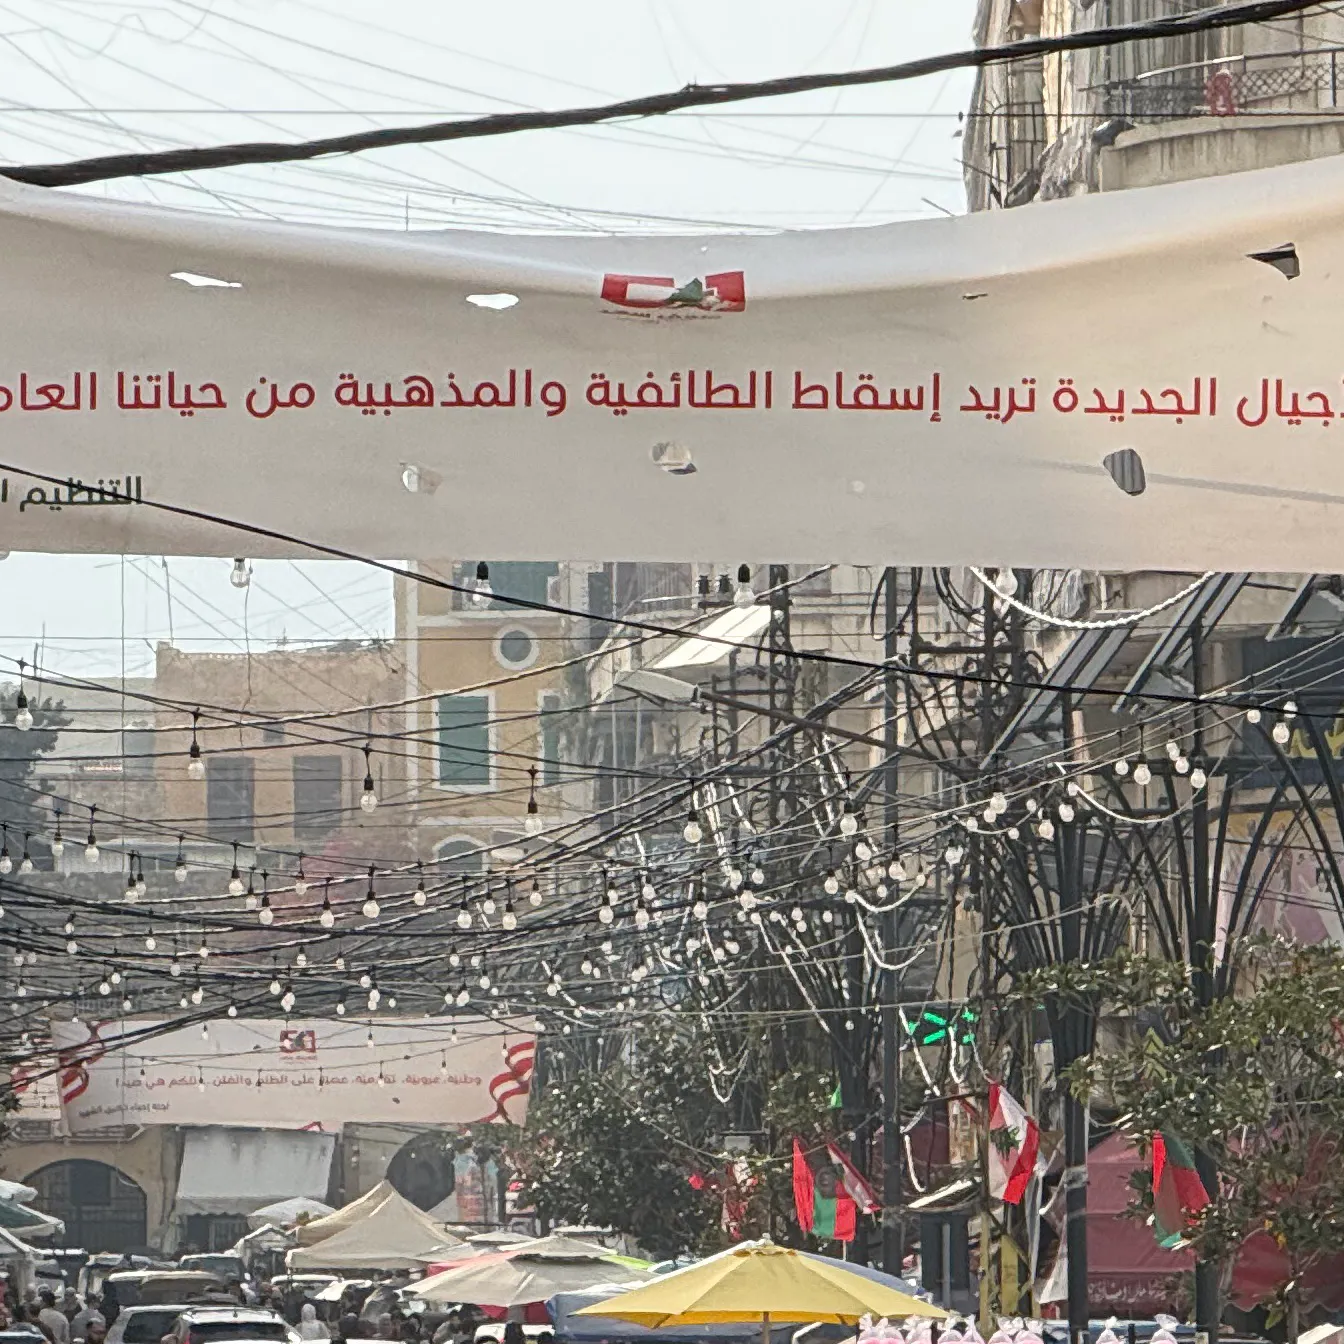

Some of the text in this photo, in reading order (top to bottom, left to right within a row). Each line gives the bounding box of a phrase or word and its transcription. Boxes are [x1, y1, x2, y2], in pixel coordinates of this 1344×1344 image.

[116, 370, 227, 418] حياتنا
[245, 376, 316, 419] من
[335, 369, 567, 418] والمذهبية
[586, 369, 771, 416] الطائفية
[791, 371, 942, 425] إسقاط
[960, 376, 1037, 424] تريد
[1055, 374, 1218, 422] الجديدة
[19, 474, 143, 512] التنظيم
